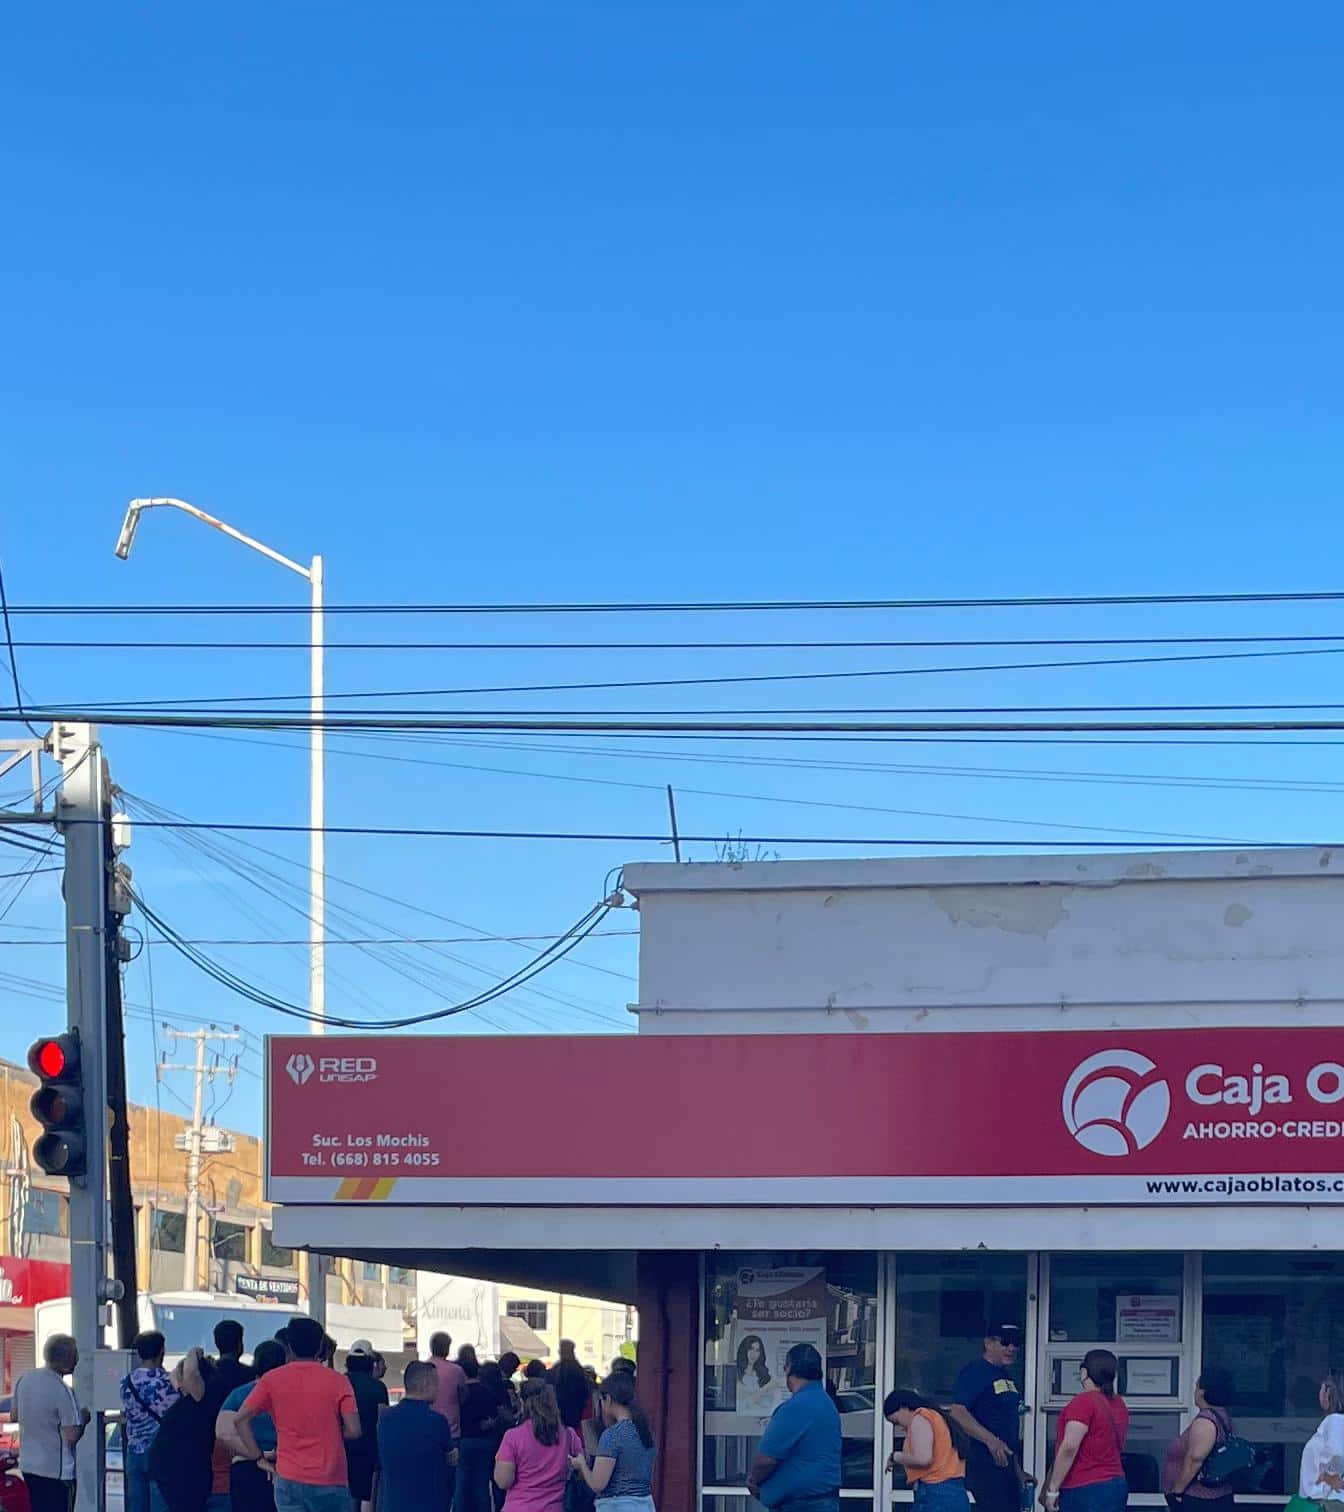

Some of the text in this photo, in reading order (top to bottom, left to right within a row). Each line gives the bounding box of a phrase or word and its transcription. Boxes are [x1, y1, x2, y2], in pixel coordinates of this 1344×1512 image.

[319, 1057, 377, 1073] RED
[1184, 1063, 1293, 1116] Caja
[312, 1133, 430, 1147] Suc. Los Mochis
[302, 1152, 440, 1167] Tel. (668) 815 4055
